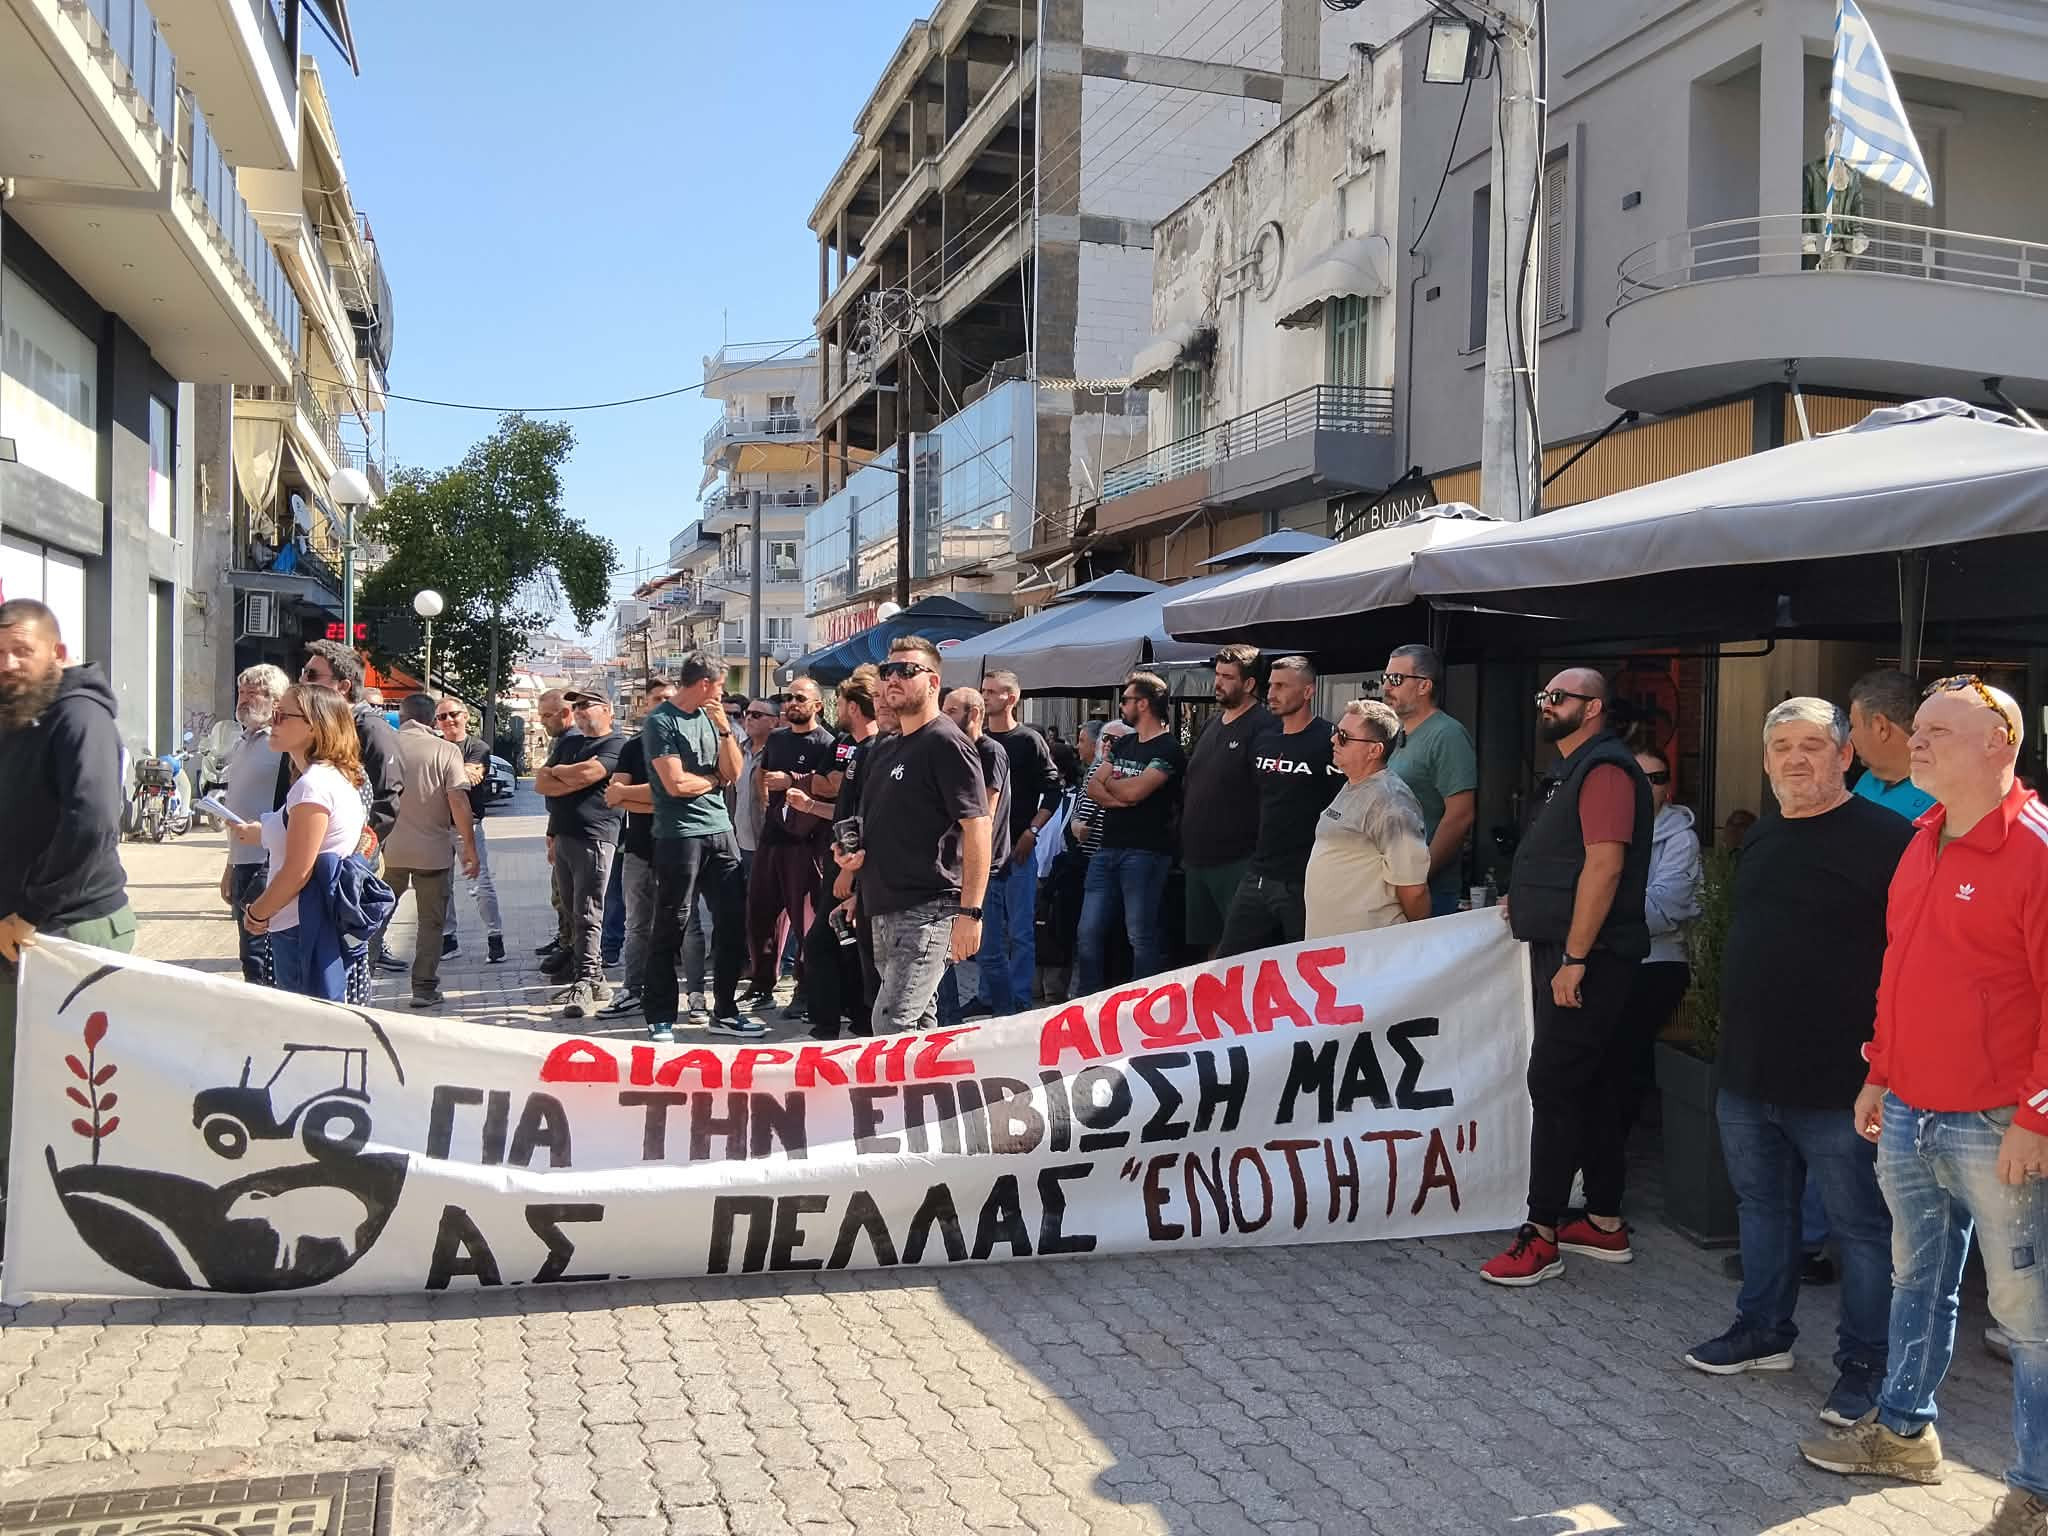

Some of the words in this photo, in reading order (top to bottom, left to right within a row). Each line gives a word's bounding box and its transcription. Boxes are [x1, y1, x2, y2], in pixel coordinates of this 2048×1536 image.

[1371, 494, 1426, 528] BUNNY
[540, 1026, 981, 1089] ΔΙΑΡΚΗΣ
[1039, 946, 1365, 1066] ΑΓΩΝΑΣ
[428, 1085, 573, 1168] ΓΙΑ
[619, 1091, 807, 1161] ΤΗΝ
[850, 1045, 1250, 1155] ΕΠΙΒΙΩΣΗ
[1275, 1017, 1454, 1124] ΜΑΣ
[708, 1162, 1097, 1274] ΠΕΛΛΑΣ
[1120, 1120, 1478, 1242] "ΕΝΟΤΗΤΑ"
